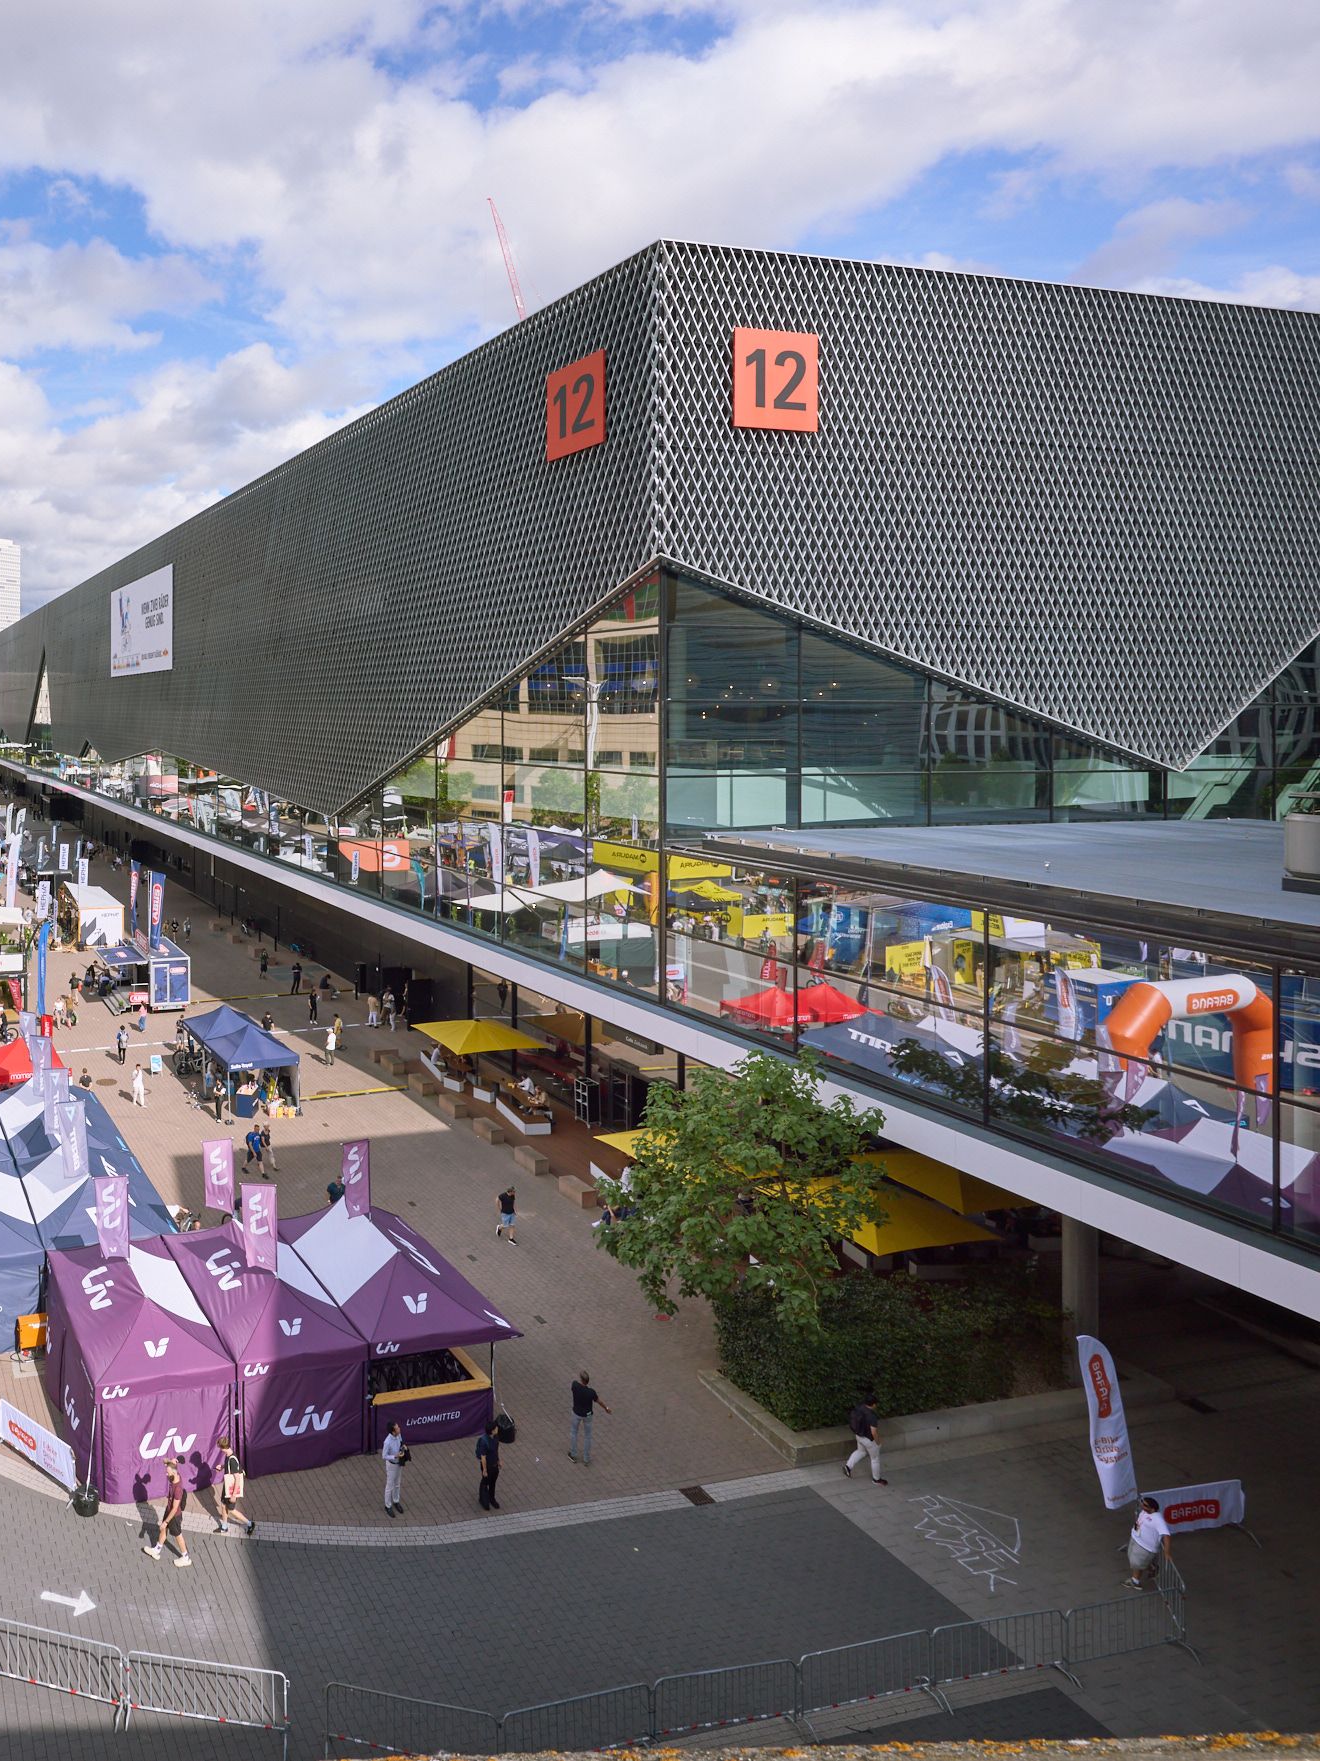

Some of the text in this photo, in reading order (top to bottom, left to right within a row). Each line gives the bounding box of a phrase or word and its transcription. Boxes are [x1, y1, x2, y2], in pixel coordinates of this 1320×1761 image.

[745, 348, 807, 412] 12
[553, 373, 595, 440] 12
[205, 1248, 243, 1291] Liv
[81, 1265, 115, 1311] Liv
[375, 1342, 400, 1354] Liv
[243, 1362, 269, 1377] Liv
[64, 1384, 80, 1431] Liv
[101, 1384, 130, 1400] Liv
[279, 1405, 333, 1436] Liv
[406, 1411, 460, 1426] LivCOMMITTED
[139, 1427, 197, 1460] Liv
[1094, 1445, 1120, 1454] Drive
[1096, 1451, 1129, 1464] System
[1171, 1504, 1216, 1520] BAFANG
[907, 1494, 1020, 1569] PLEASE
[913, 1517, 1018, 1592] WALK
